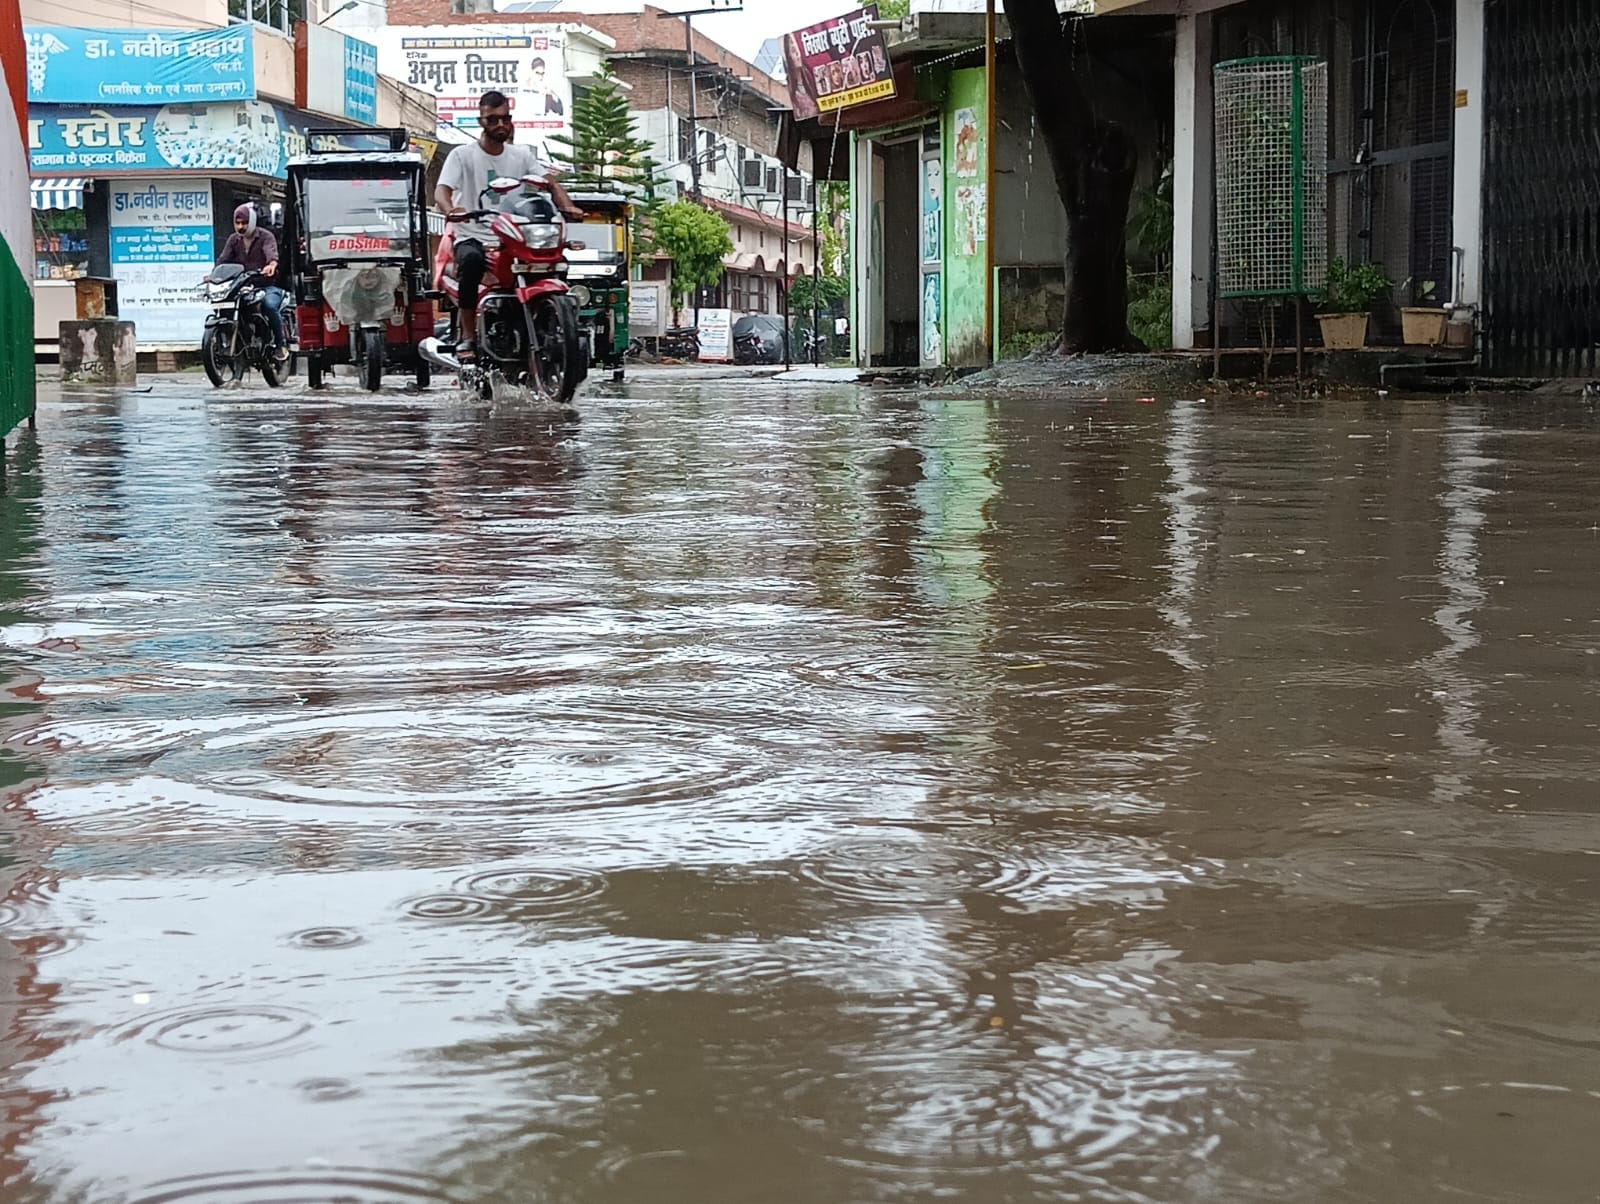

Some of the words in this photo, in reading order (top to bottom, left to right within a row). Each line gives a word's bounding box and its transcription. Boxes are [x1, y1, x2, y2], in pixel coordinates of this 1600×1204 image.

[84, 38, 116, 59] डा.
[122, 33, 180, 58] नवीन
[186, 36, 245, 58] सहाय
[407, 59, 458, 93] अमृत
[464, 53, 519, 84] विचार
[144, 82, 162, 95] रोग
[166, 81, 180, 95] एवं
[184, 82, 203, 94] नशा
[57, 109, 146, 147] स्टोर
[66, 151, 77, 165] के
[79, 152, 114, 167] फुटकर
[116, 149, 146, 164] विक्रेता
[172, 191, 209, 211] सहाय
